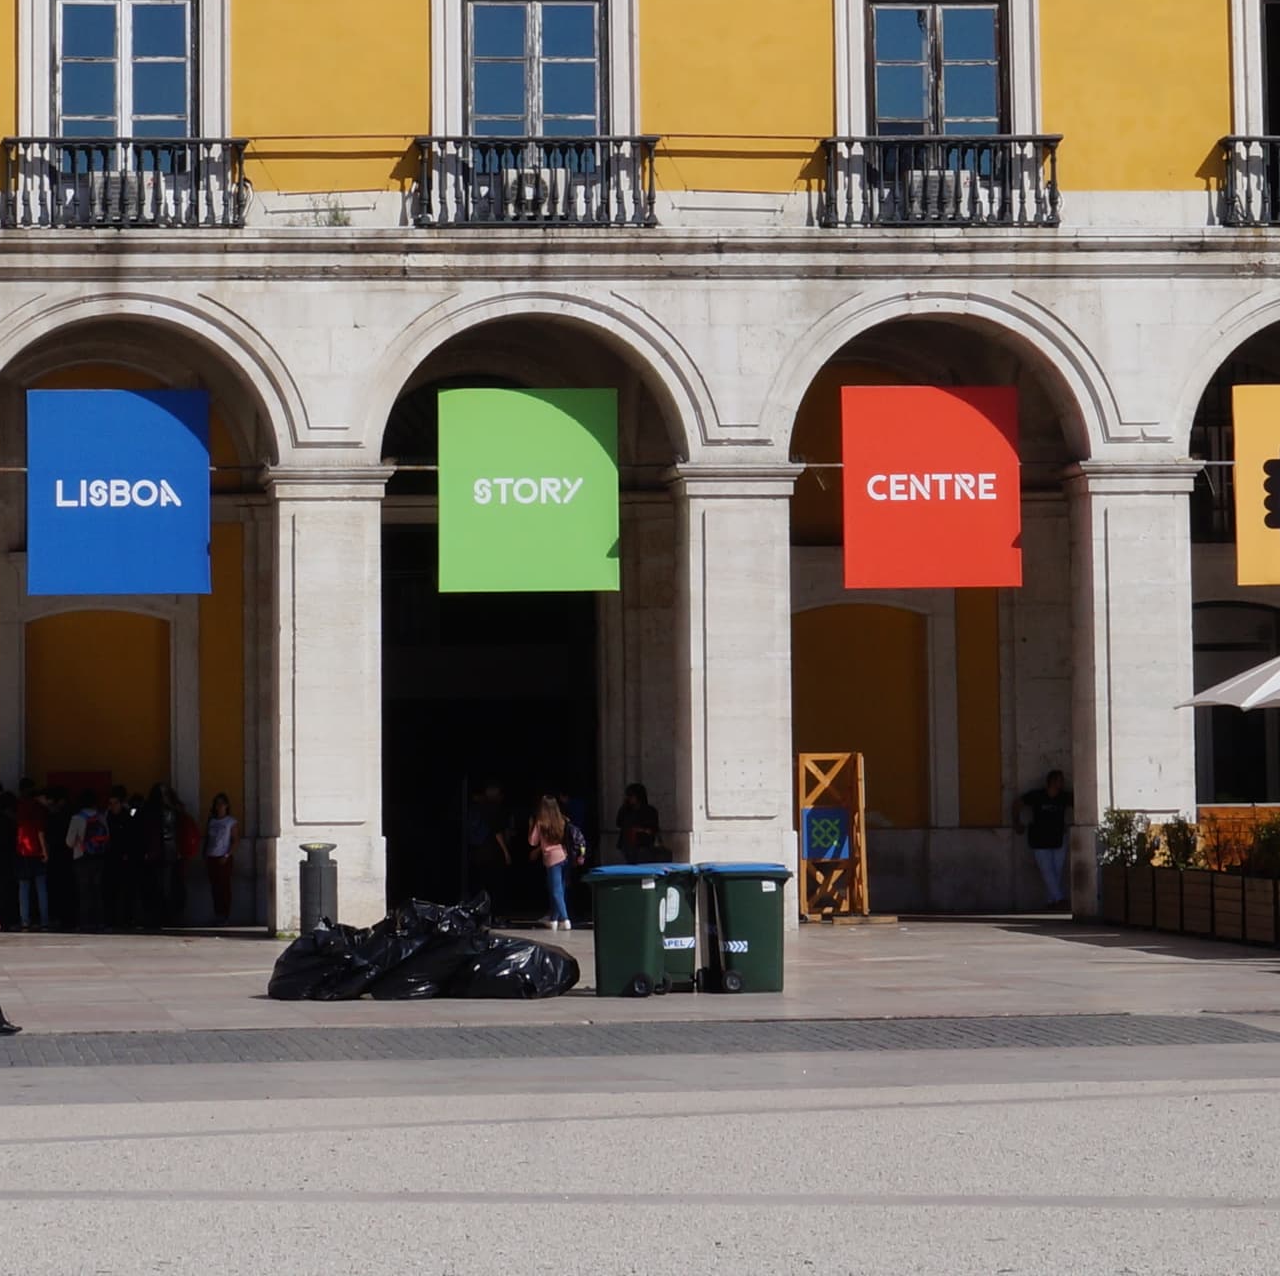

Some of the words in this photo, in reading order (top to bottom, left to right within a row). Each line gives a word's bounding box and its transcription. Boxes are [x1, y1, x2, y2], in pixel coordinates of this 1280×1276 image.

[56, 479, 182, 507] LISBOA
[473, 477, 584, 505] STORY
[866, 473, 997, 501] CENTRE
